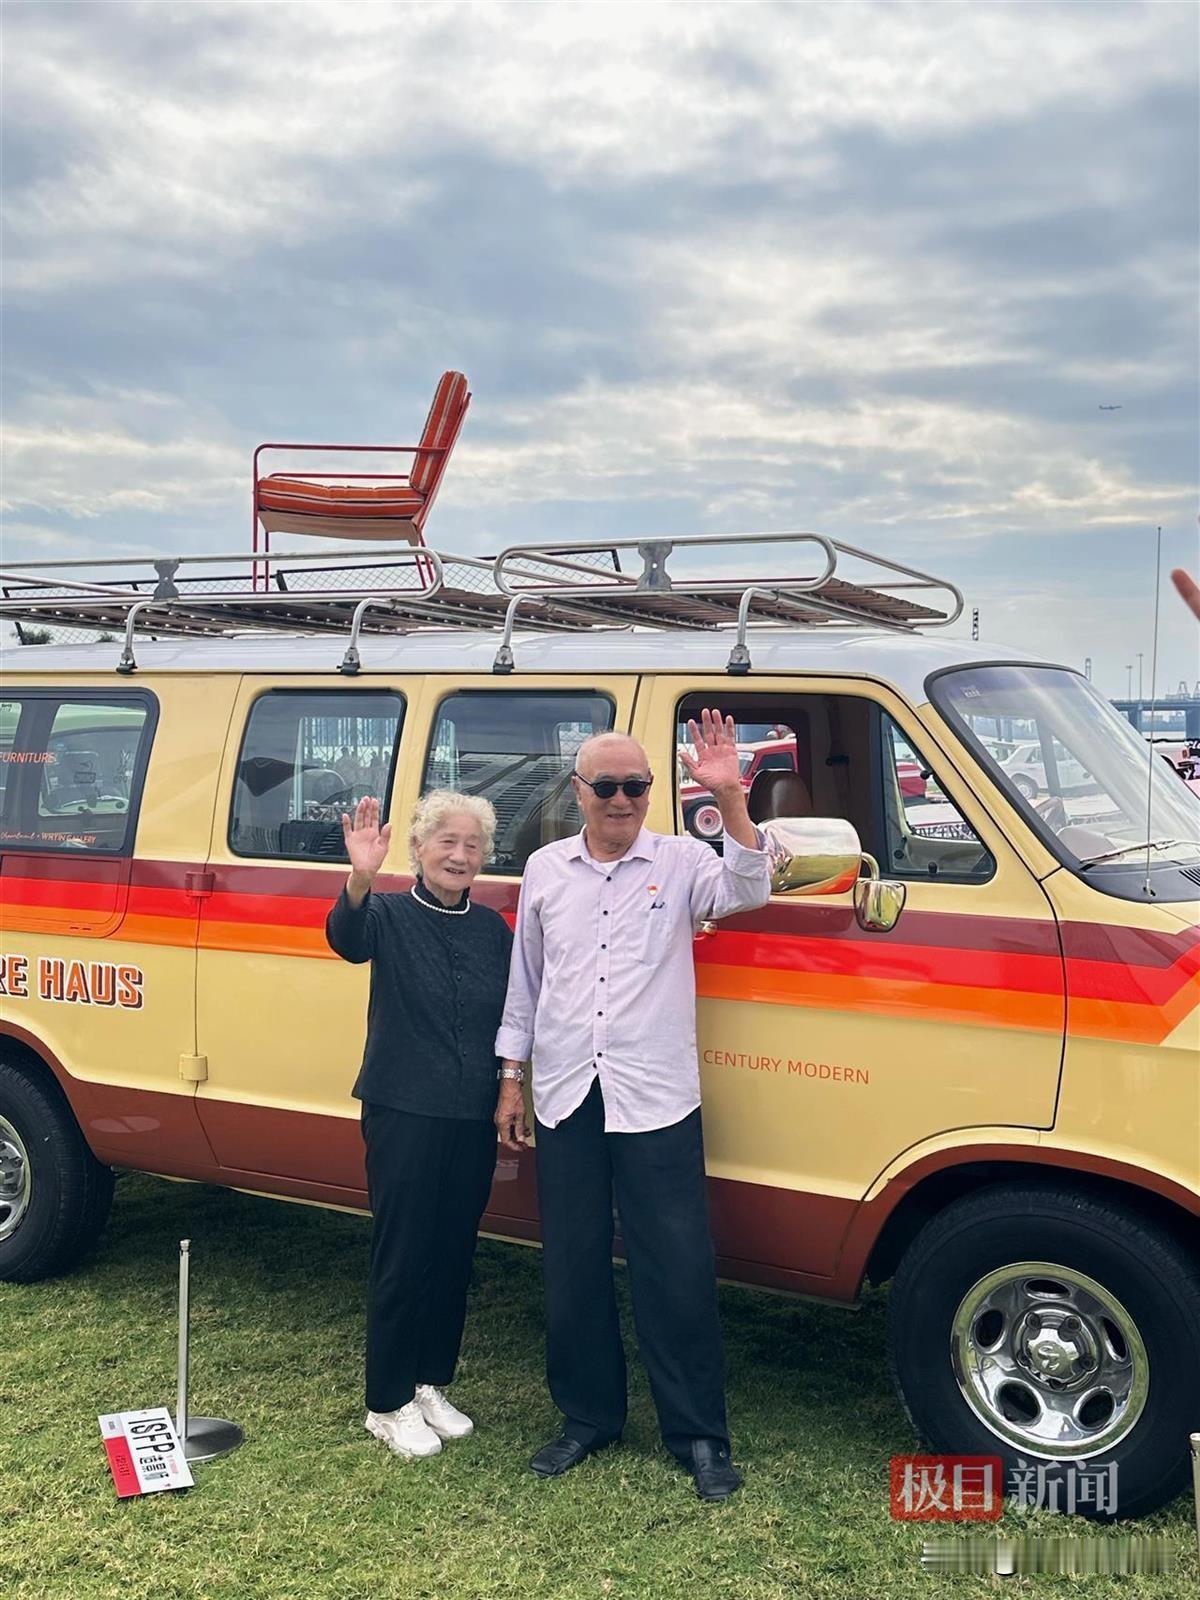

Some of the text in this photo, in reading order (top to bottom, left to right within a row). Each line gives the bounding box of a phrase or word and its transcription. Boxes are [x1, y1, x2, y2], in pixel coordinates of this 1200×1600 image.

[39, 957, 144, 1010] HAUS
[703, 1050, 869, 1085] CENTURY MODERN
[128, 1417, 176, 1453] ISFP
